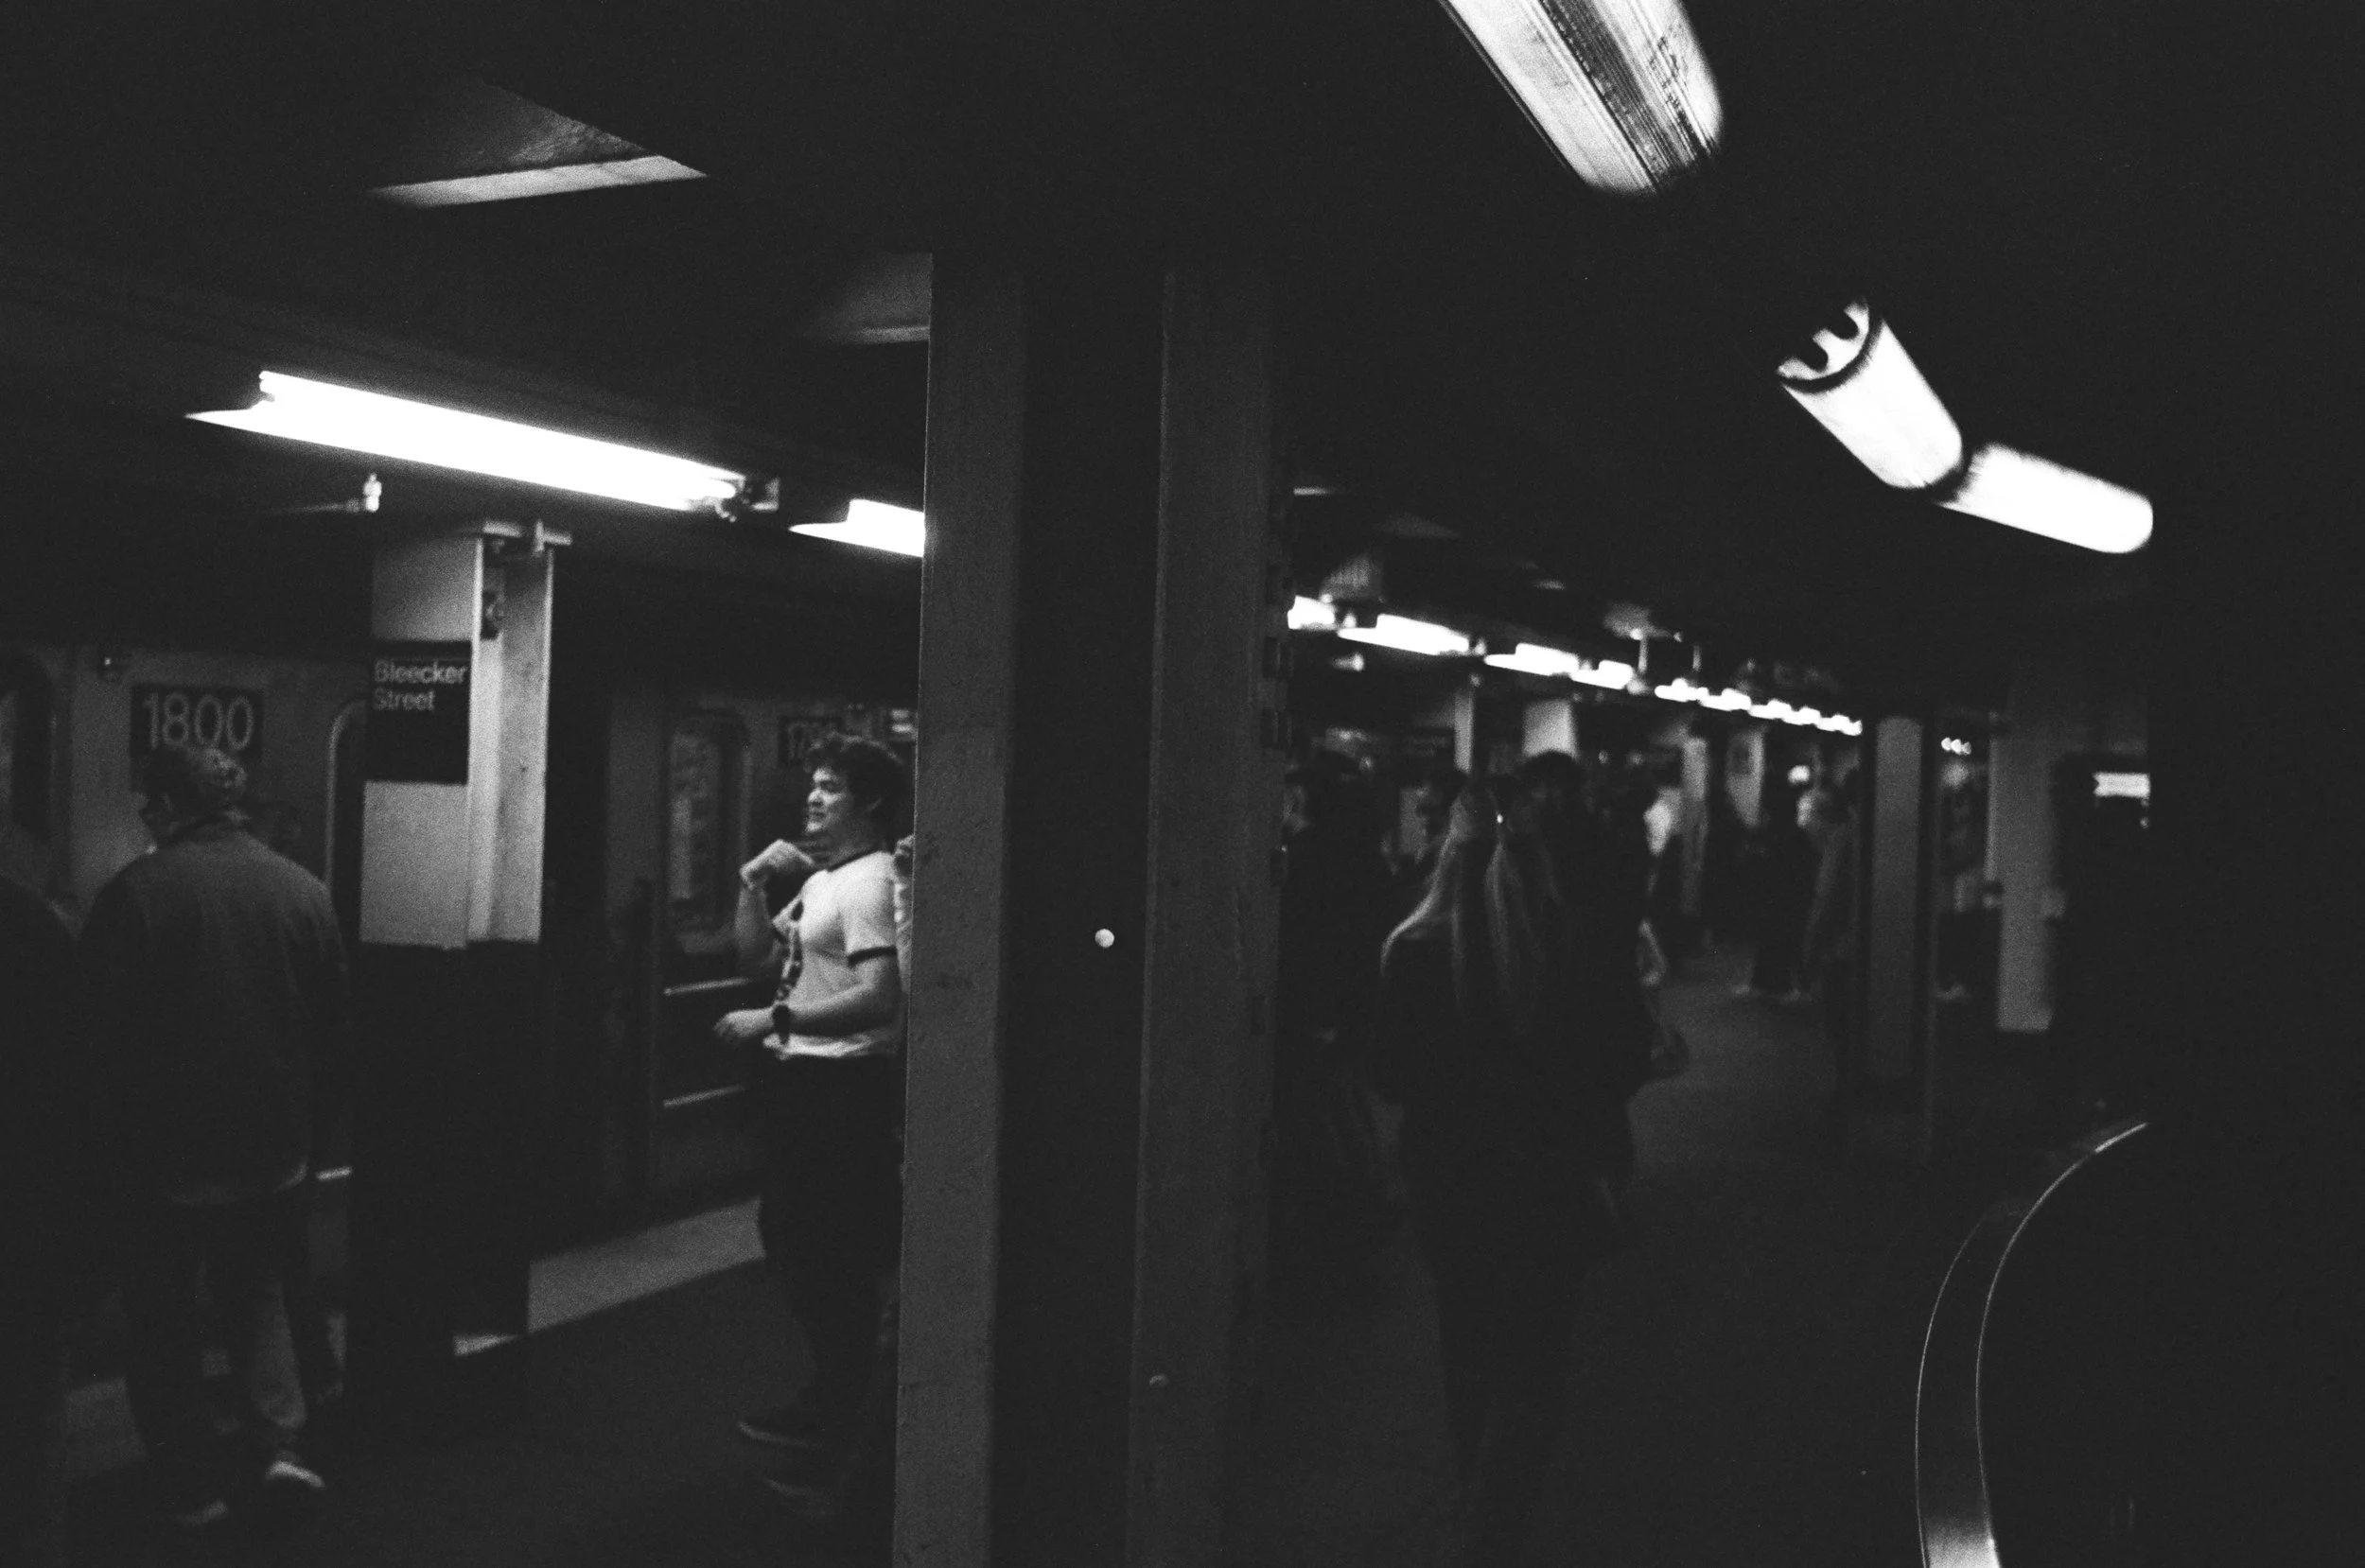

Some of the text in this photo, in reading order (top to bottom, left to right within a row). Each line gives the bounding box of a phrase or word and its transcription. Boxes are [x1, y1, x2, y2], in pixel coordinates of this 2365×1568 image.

[375, 658, 466, 684] Bleecker
[374, 686, 435, 712] Street
[142, 691, 254, 751] 1800
